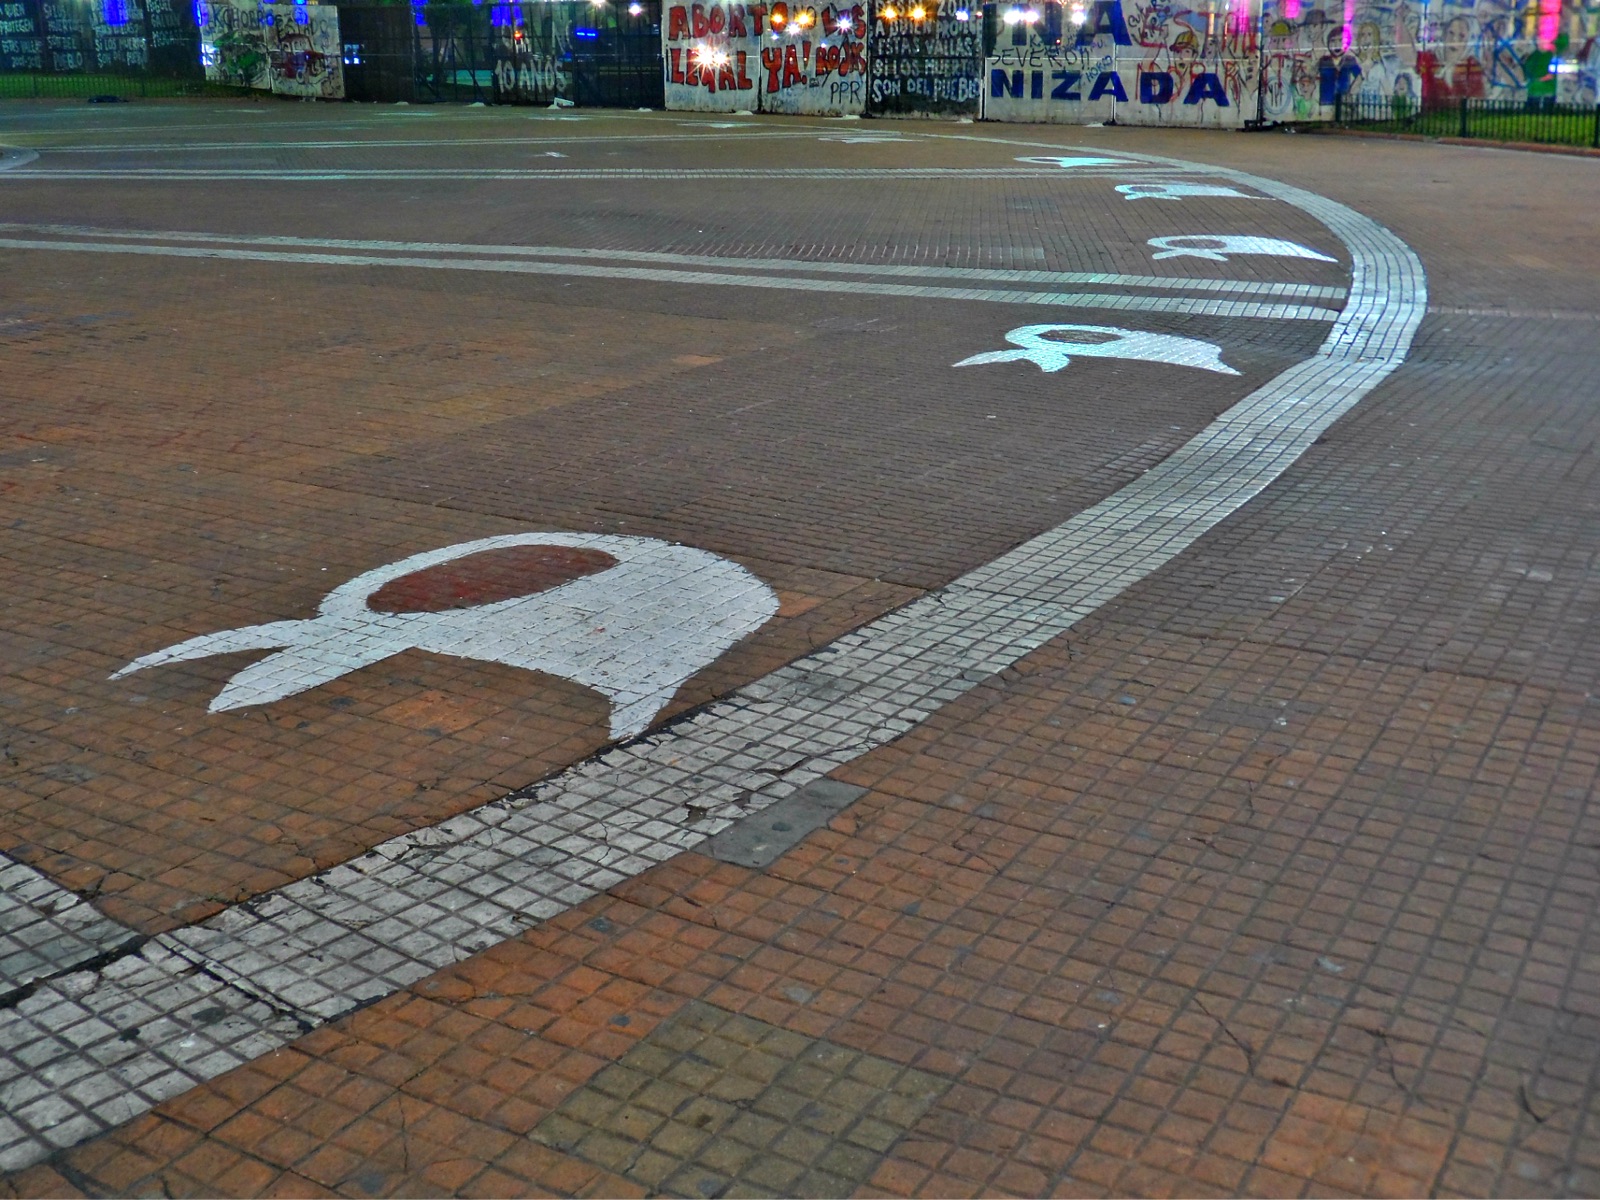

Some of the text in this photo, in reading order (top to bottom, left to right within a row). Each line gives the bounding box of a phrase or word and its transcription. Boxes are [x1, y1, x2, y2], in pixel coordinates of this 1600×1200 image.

[668, 2, 789, 41] ABORTO
[878, 37, 920, 56] ESTAS
[495, 60, 516, 94] 10
[872, 77, 981, 103] SON DEL PUEBLO
[991, 69, 1230, 107] NIZADA
[830, 80, 862, 105] PPR
